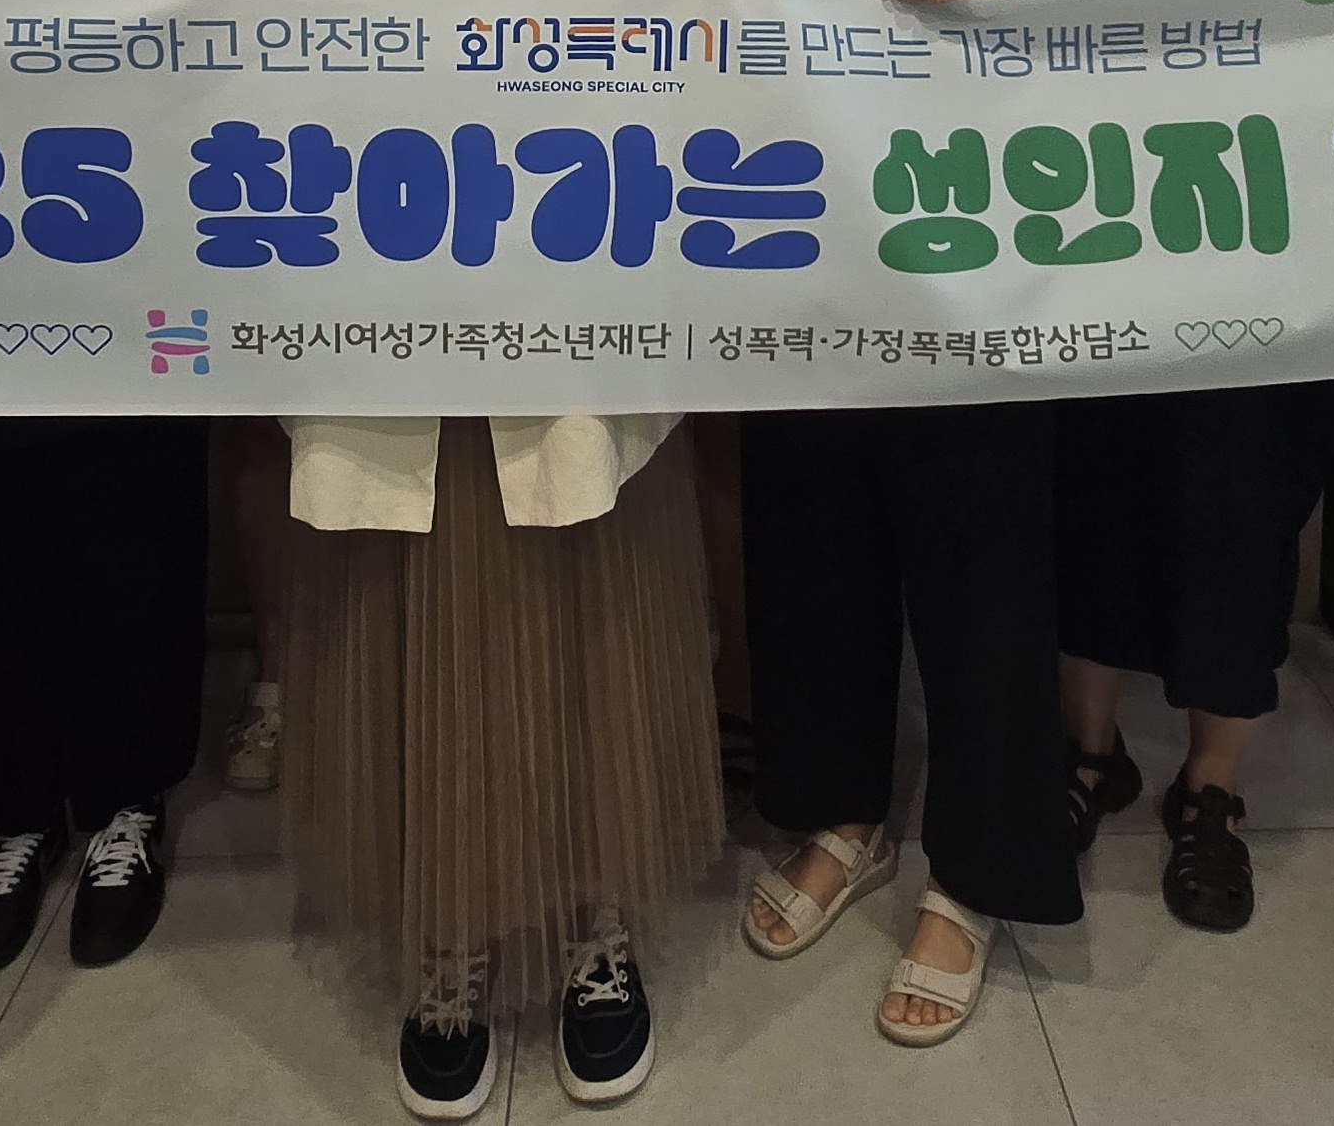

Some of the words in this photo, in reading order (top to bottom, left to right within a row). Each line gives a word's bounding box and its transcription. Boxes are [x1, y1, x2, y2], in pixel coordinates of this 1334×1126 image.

[4, 17, 245, 75] 평등하고
[257, 16, 432, 74] 안전한
[801, 23, 933, 79] 만드는
[940, 25, 1036, 78] 가장
[1047, 19, 1150, 75] 빠른
[1160, 17, 1265, 72] 방법
[497, 80, 585, 94] HWASEONG
[587, 80, 650, 94] SPECIAL
[652, 81, 687, 95] CITY
[189, 119, 827, 270] 찾아가는
[872, 113, 1291, 274] 성인지
[230, 320, 673, 363] 화성시여성가족청소년재단
[708, 320, 1151, 367] 성폭력·가정폭력통합상담소
